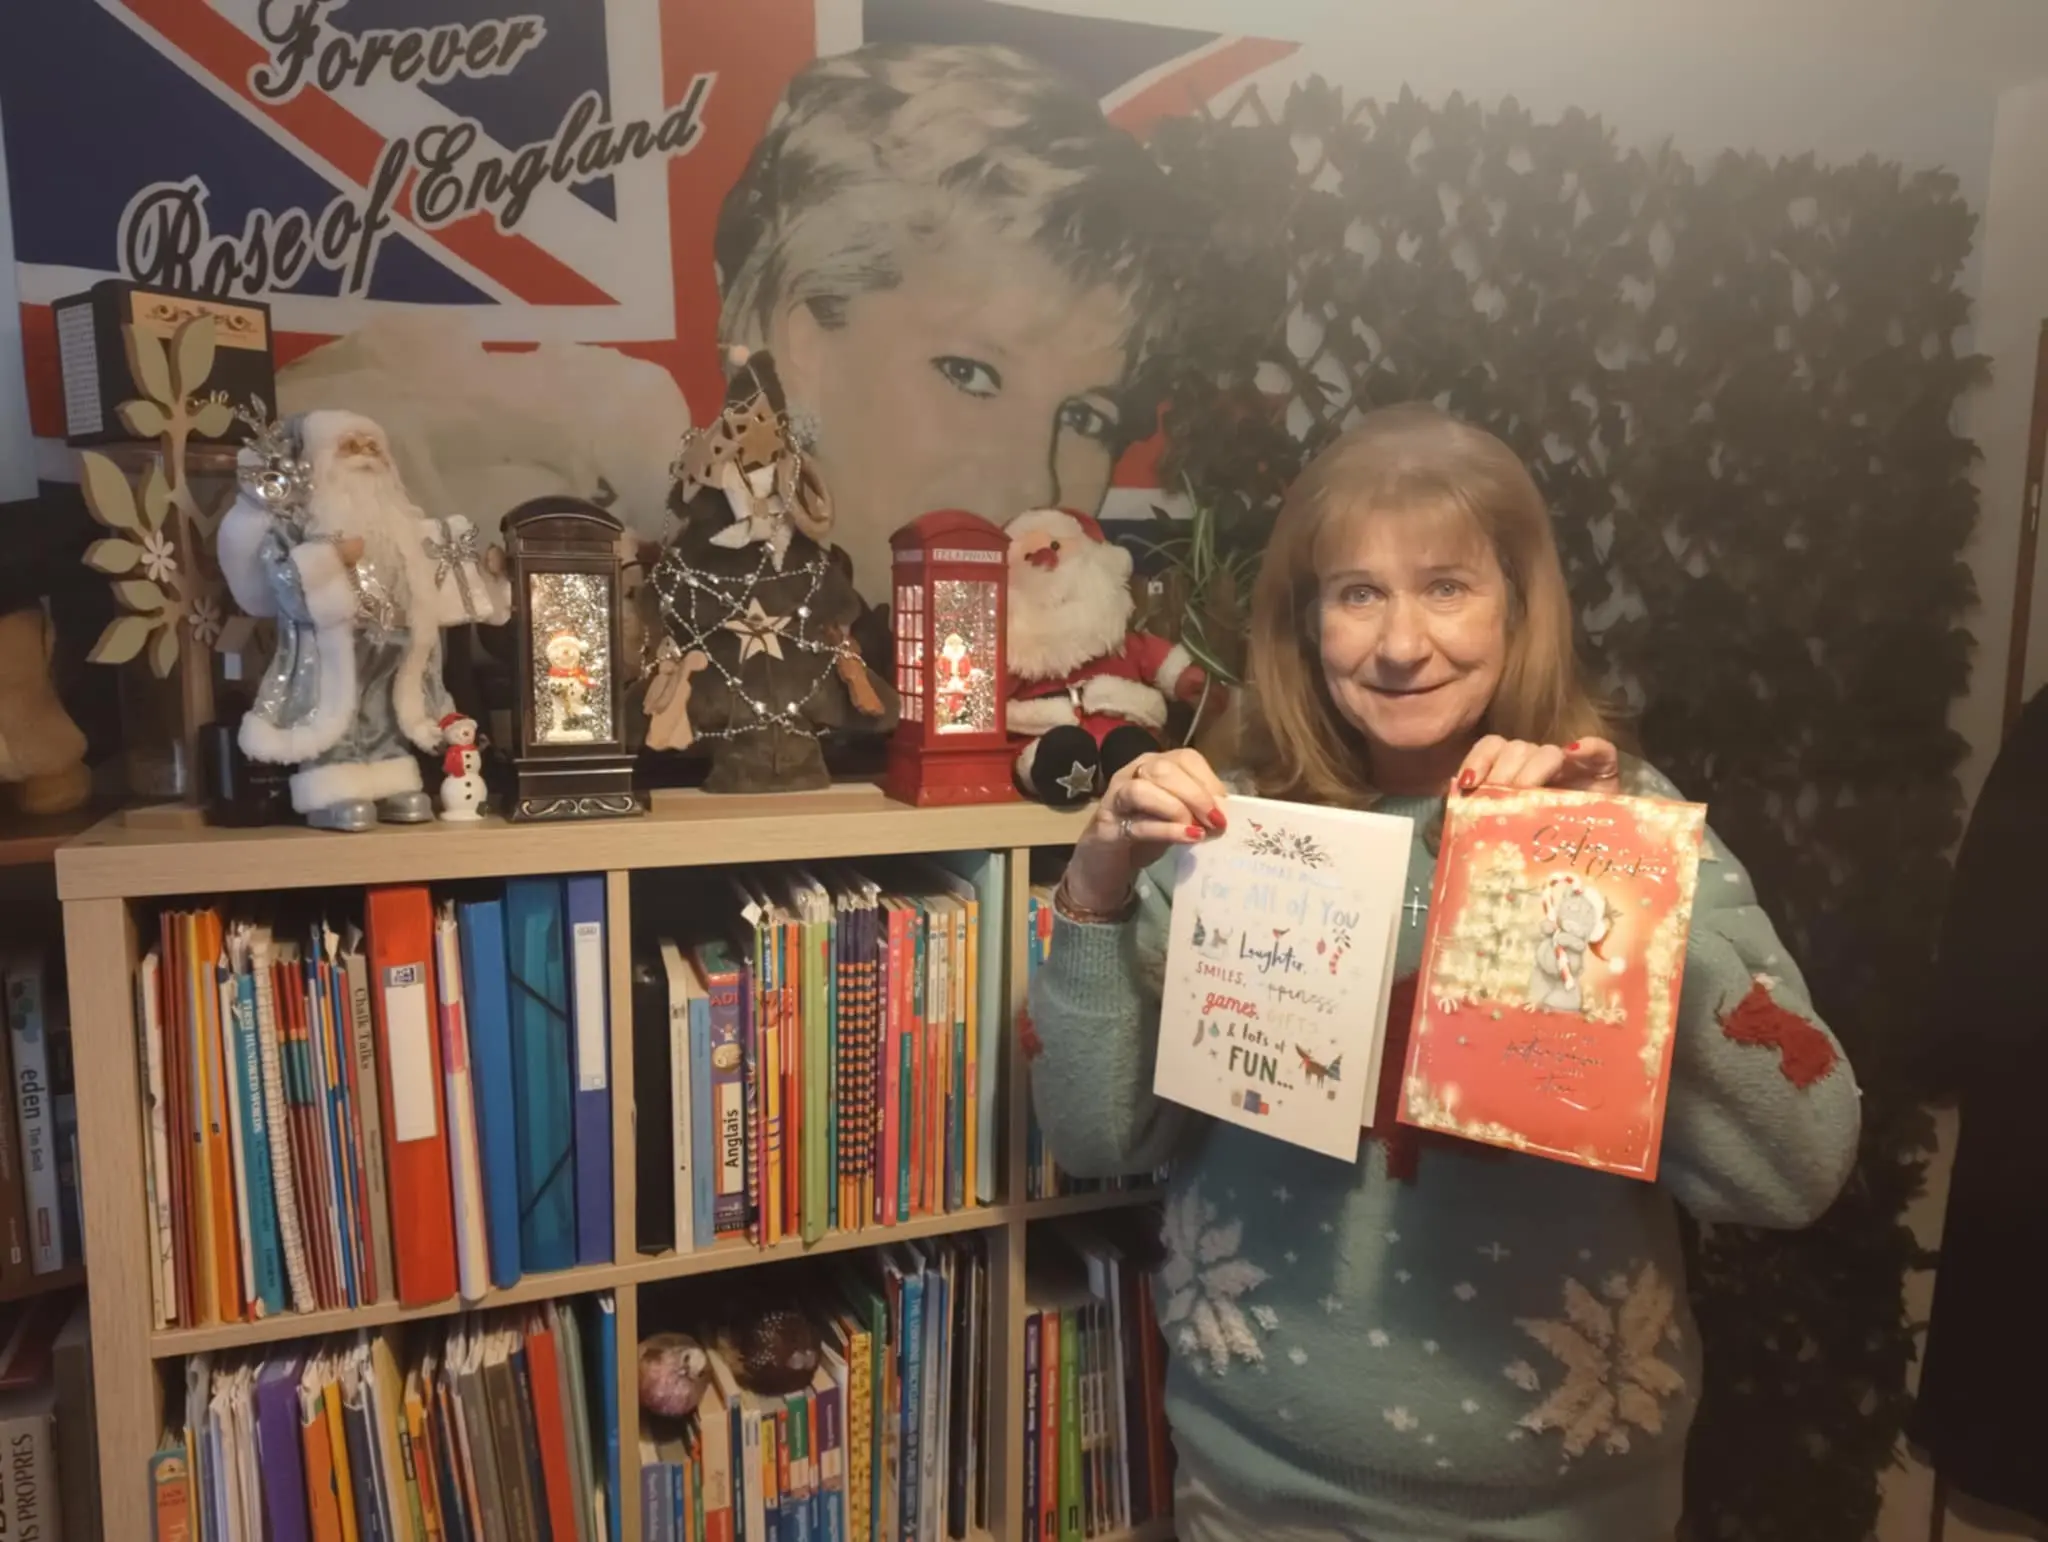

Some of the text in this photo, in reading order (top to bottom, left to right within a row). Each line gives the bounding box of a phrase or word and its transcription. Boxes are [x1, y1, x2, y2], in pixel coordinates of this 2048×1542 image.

[256, 0, 541, 97] Forever
[126, 77, 707, 297] Rose of England
[1195, 961, 1246, 988] SMILES,
[354, 988, 371, 1070] Chalk Talks
[1202, 992, 1259, 1020] games,
[1227, 1022, 1236, 1037] &
[1242, 1022, 1269, 1047] lots
[241, 999, 263, 1133] FIRST HUNDRED WORDS
[1228, 1044, 1294, 1090] FUN...
[21, 1069, 46, 1120] eden
[29, 1126, 44, 1172] Tim Smit
[724, 1109, 743, 1168] Anglais
[12, 1434, 37, 1521] PROPRES
